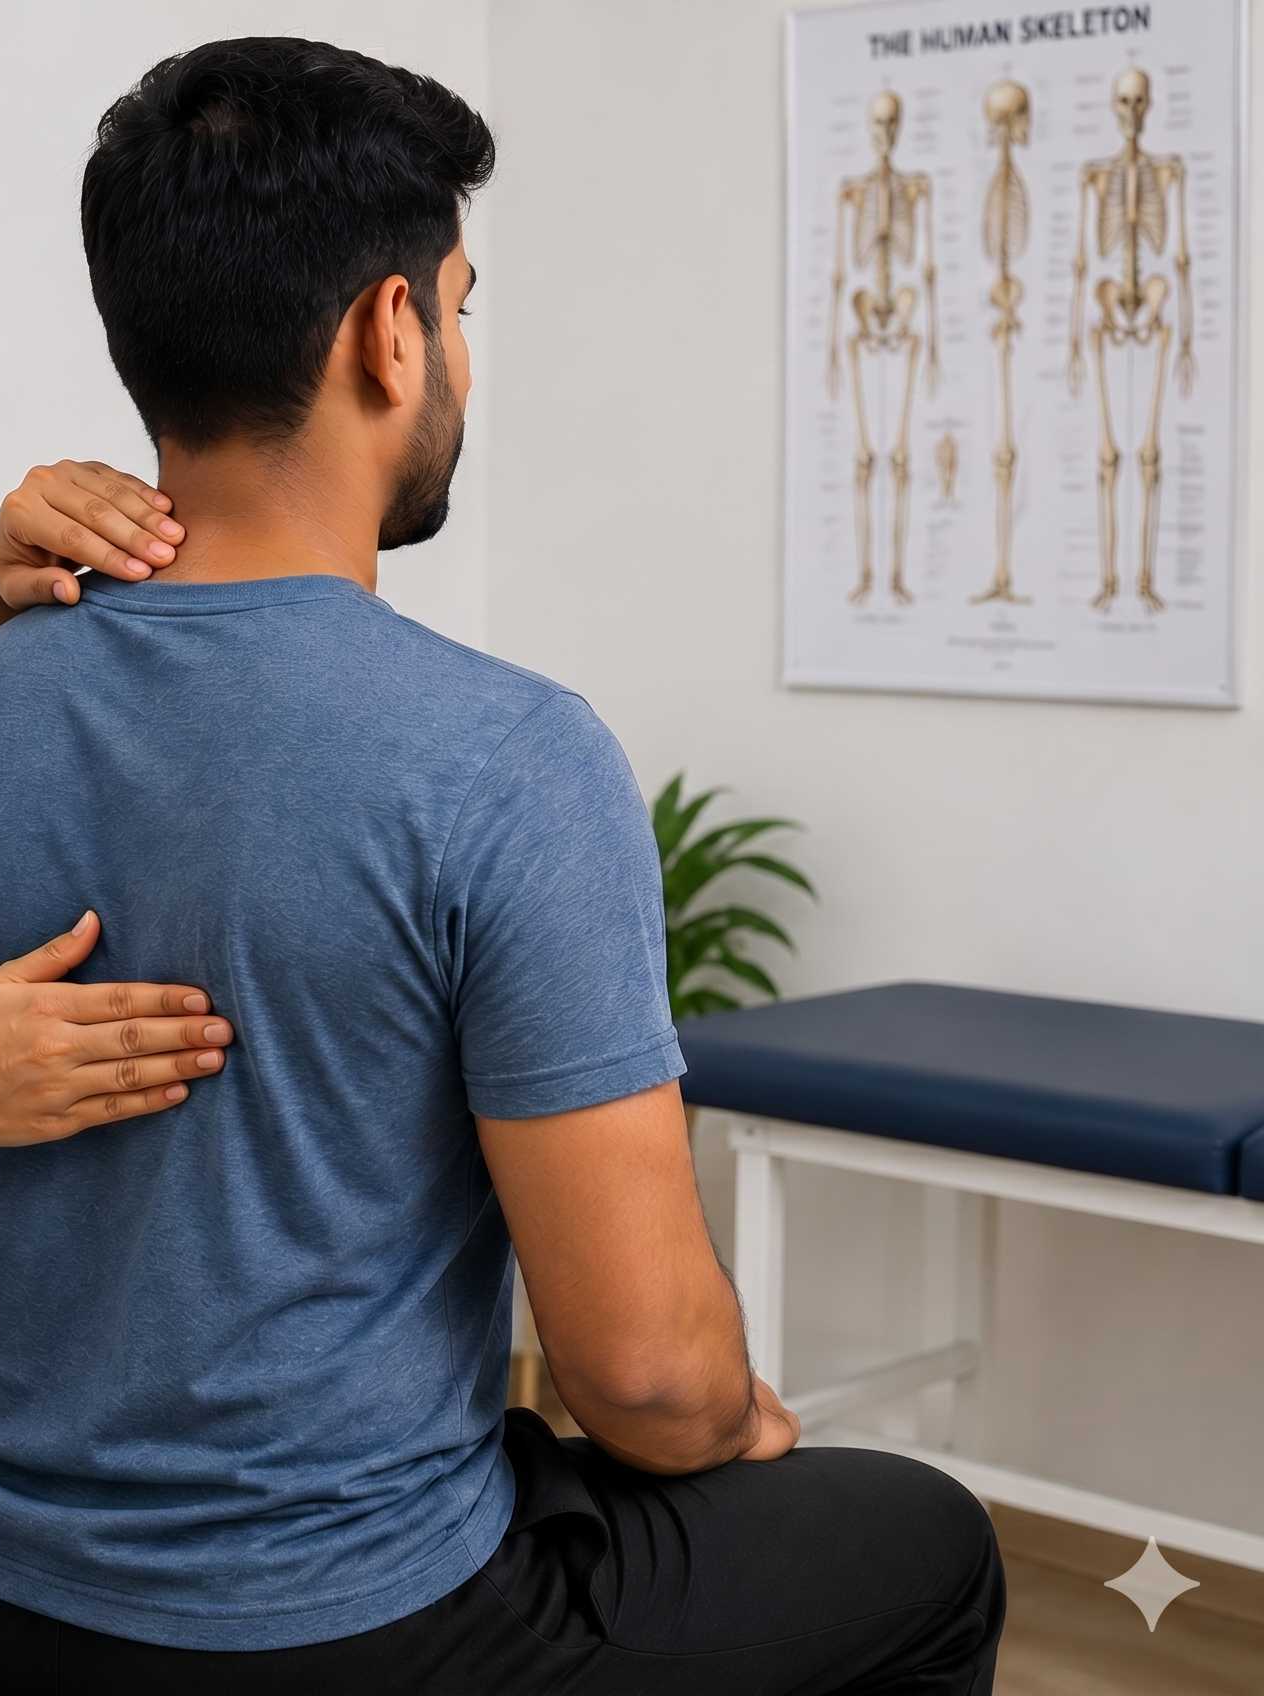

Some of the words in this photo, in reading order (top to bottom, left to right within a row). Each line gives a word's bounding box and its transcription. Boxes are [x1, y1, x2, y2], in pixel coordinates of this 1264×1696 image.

[868, 30, 913, 59] THE
[921, 21, 1012, 54] HUMAN
[1020, 5, 1151, 43] SKELETON
